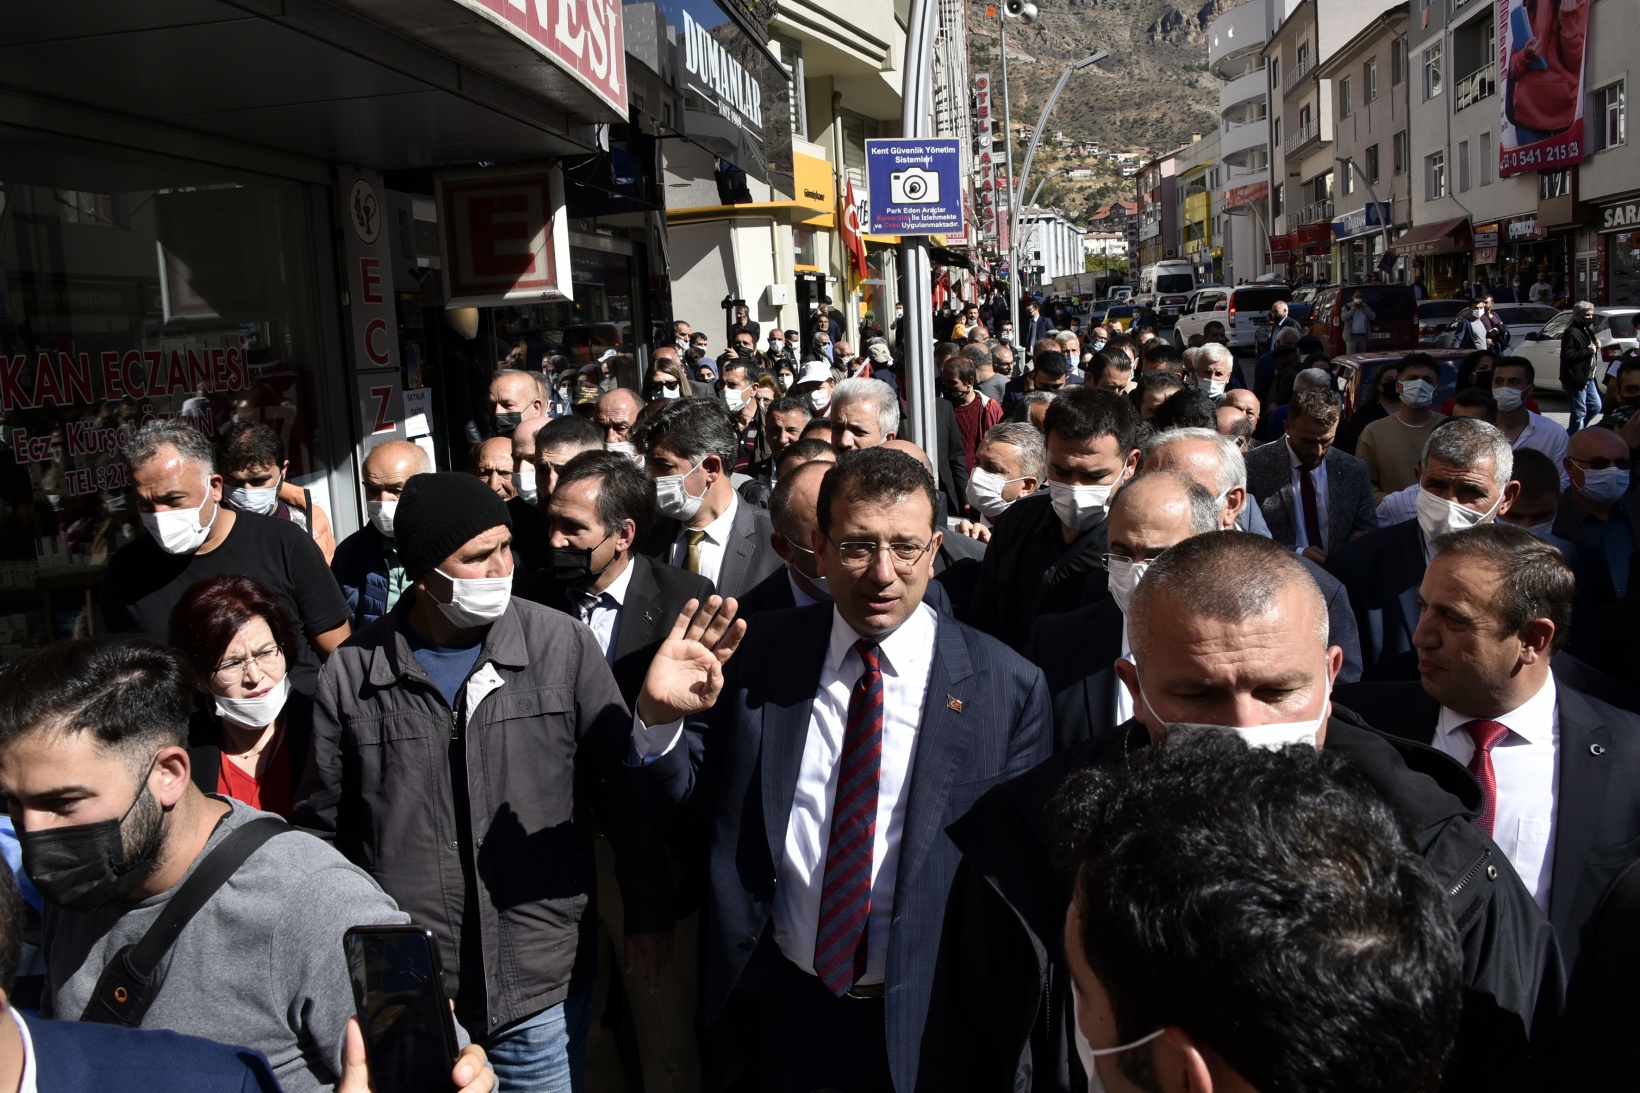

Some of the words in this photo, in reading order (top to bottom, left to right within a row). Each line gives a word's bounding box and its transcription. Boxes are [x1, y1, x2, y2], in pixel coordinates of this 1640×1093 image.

[683, 9, 762, 129] DUMANLAR
[977, 76, 989, 131] OTEL
[871, 147, 889, 155] Kent
[890, 146, 924, 155] Güvenlik
[925, 145, 956, 154] Yönetim
[895, 155, 933, 164] Sistemleri
[1519, 147, 1542, 166] 541
[1546, 144, 1566, 162] 215
[981, 151, 996, 233] ATALAY
[911, 213, 920, 221] İle
[921, 213, 957, 221] İzlenmekte
[922, 206, 946, 215] Araçlar
[468, 194, 537, 277] E
[100, 333, 251, 402] ECZANESİ
[12, 427, 62, 465] Ecz.
[65, 467, 97, 497] TEL
[106, 462, 131, 490] 21
